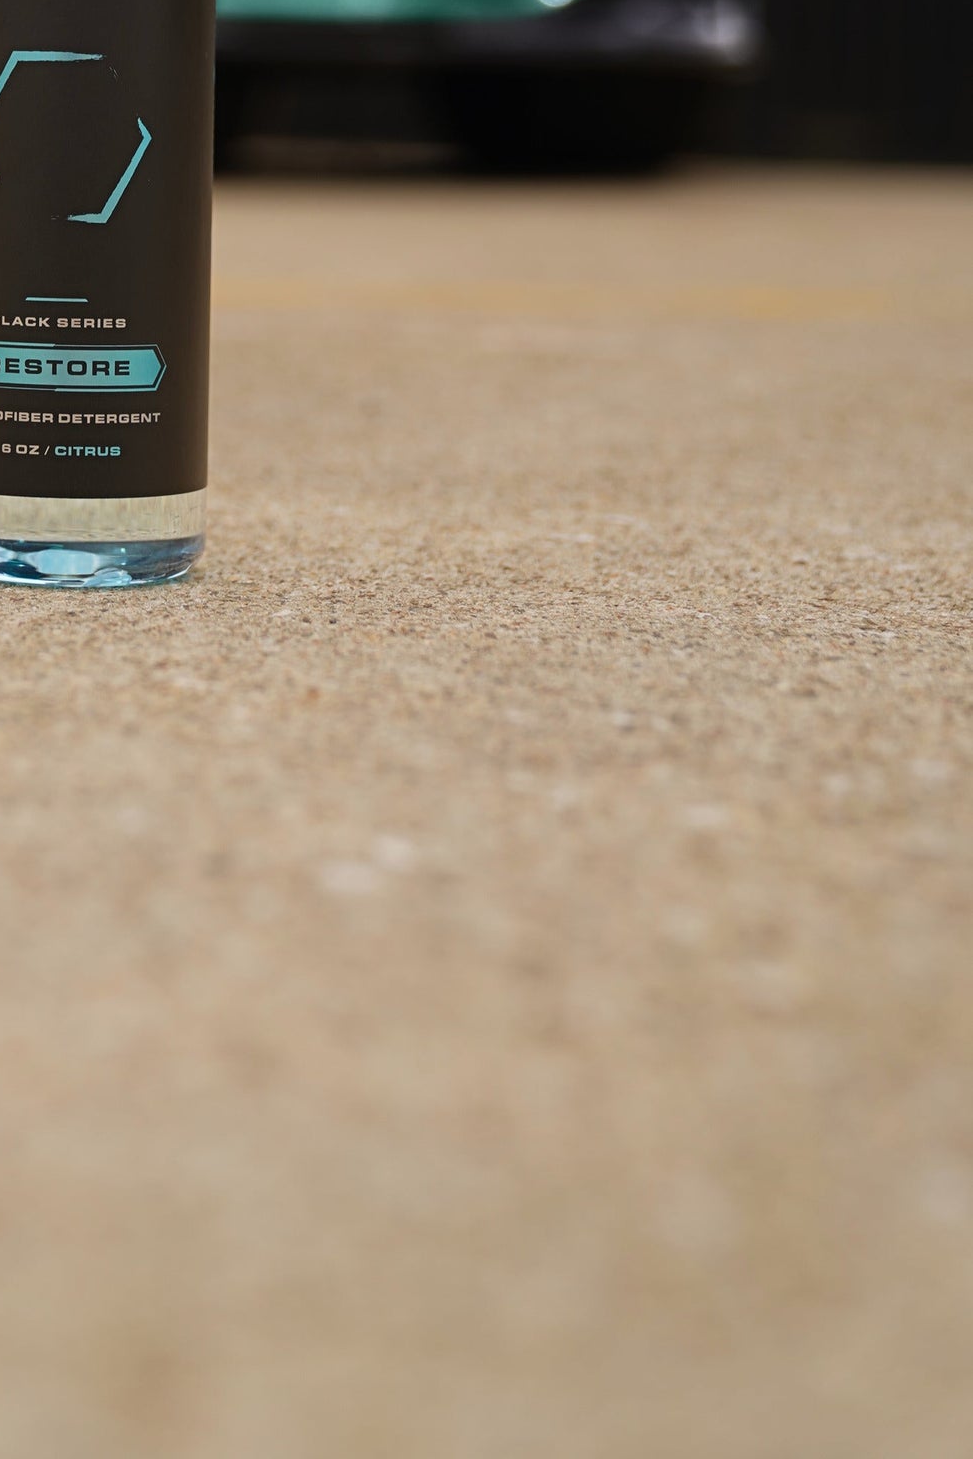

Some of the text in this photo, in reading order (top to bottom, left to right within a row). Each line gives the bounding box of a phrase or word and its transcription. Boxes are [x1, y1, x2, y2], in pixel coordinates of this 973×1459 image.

[56, 317, 127, 329] SERIES
[57, 412, 162, 424] DETERGENT
[15, 444, 40, 456] OZ
[54, 445, 122, 457] CITRUS
